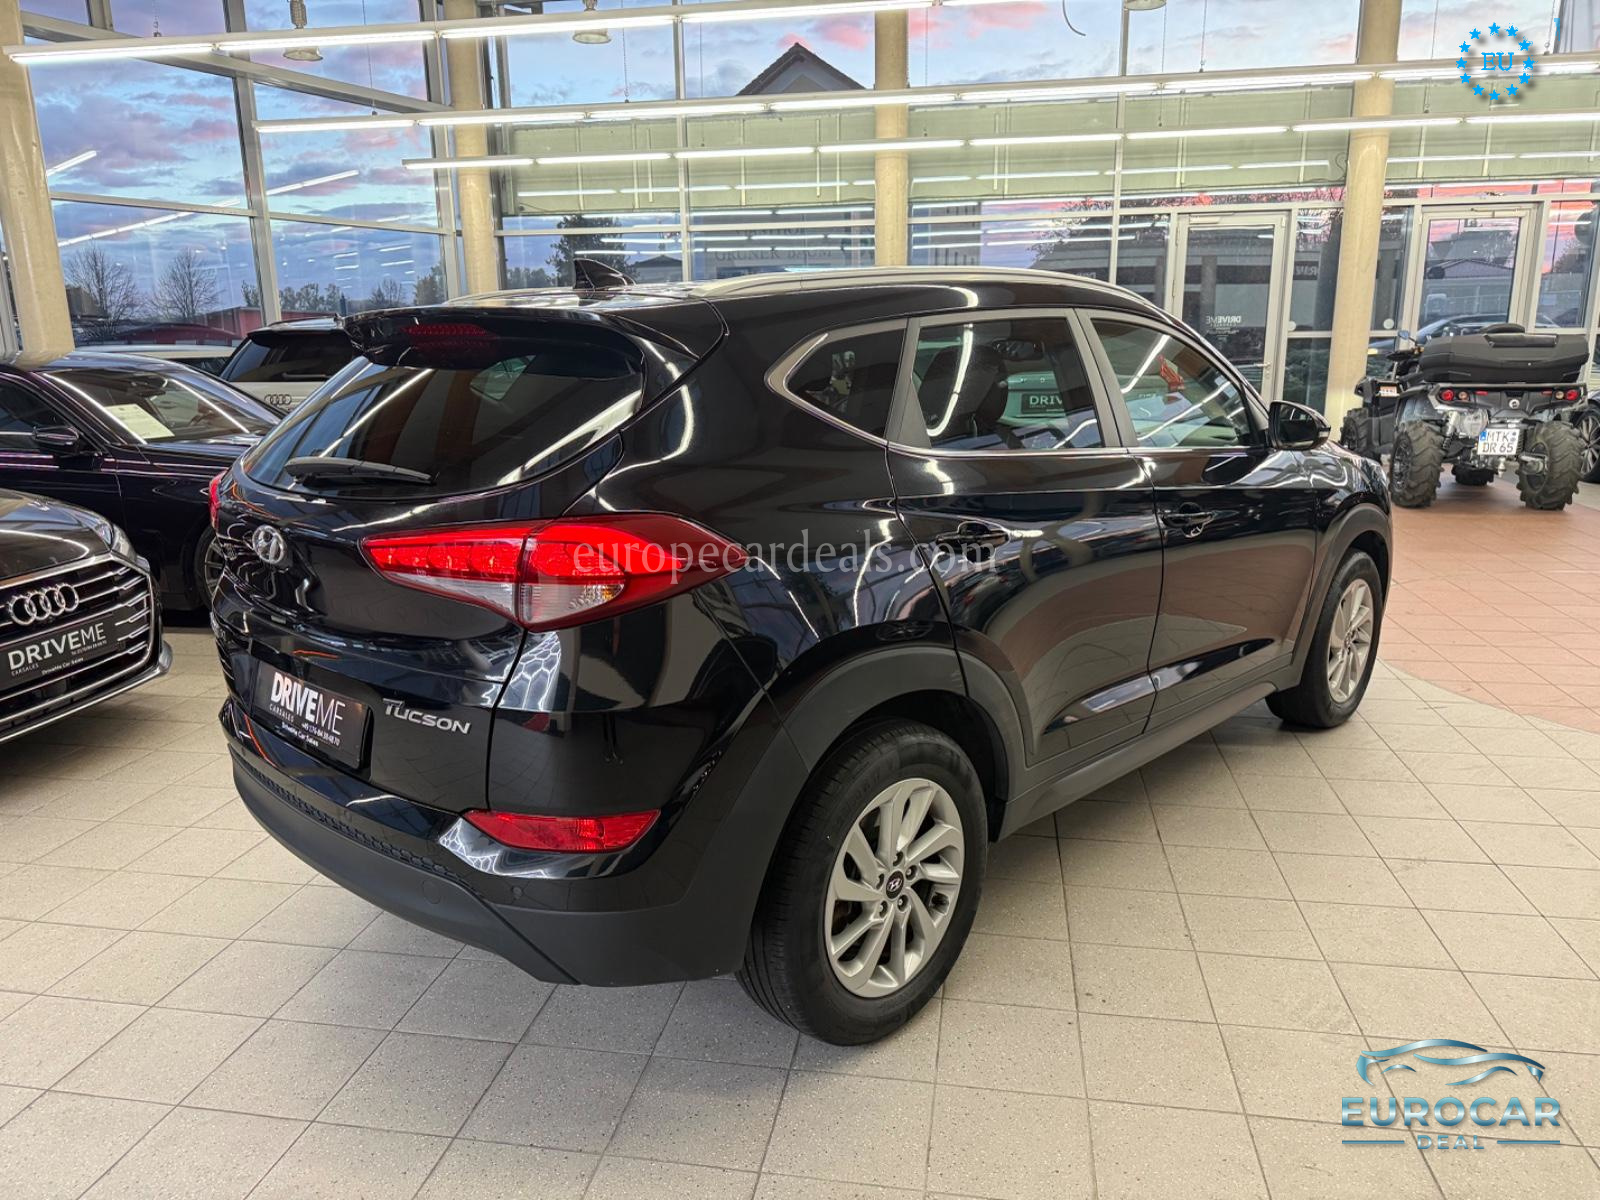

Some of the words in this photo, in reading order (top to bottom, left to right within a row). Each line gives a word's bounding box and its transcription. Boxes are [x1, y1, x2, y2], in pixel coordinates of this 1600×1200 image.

[1482, 443, 1497, 453] DR
[1499, 443, 1514, 453] 65
[1486, 431, 1509, 442] MTK
[8, 622, 107, 671] DRIVEME
[270, 672, 346, 735] DRIVEME
[383, 698, 471, 734] TUCSON
